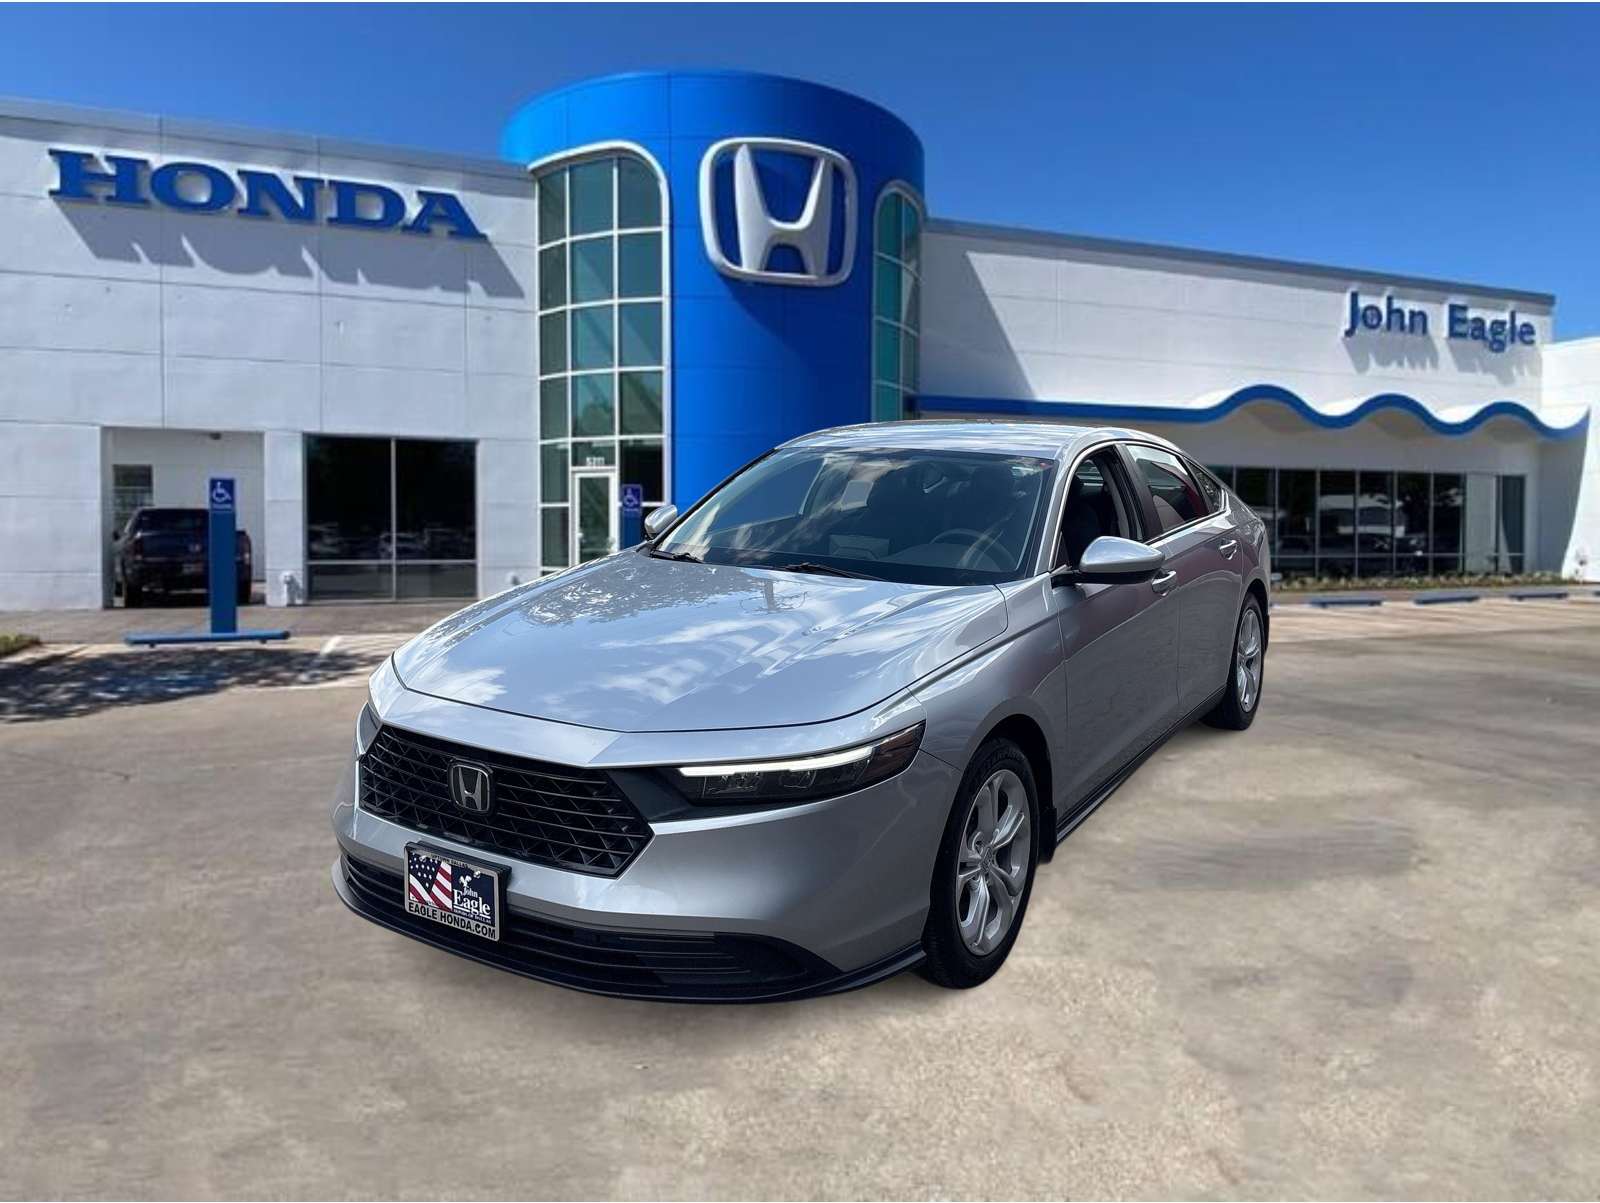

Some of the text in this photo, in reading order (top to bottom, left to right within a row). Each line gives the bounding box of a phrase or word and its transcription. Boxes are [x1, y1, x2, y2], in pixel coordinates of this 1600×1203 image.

[48, 148, 488, 240] HONDA
[1344, 291, 1535, 353] John Eagle
[453, 889, 491, 916] Eagle
[463, 886, 478, 899] John
[408, 902, 438, 920] EAGLE
